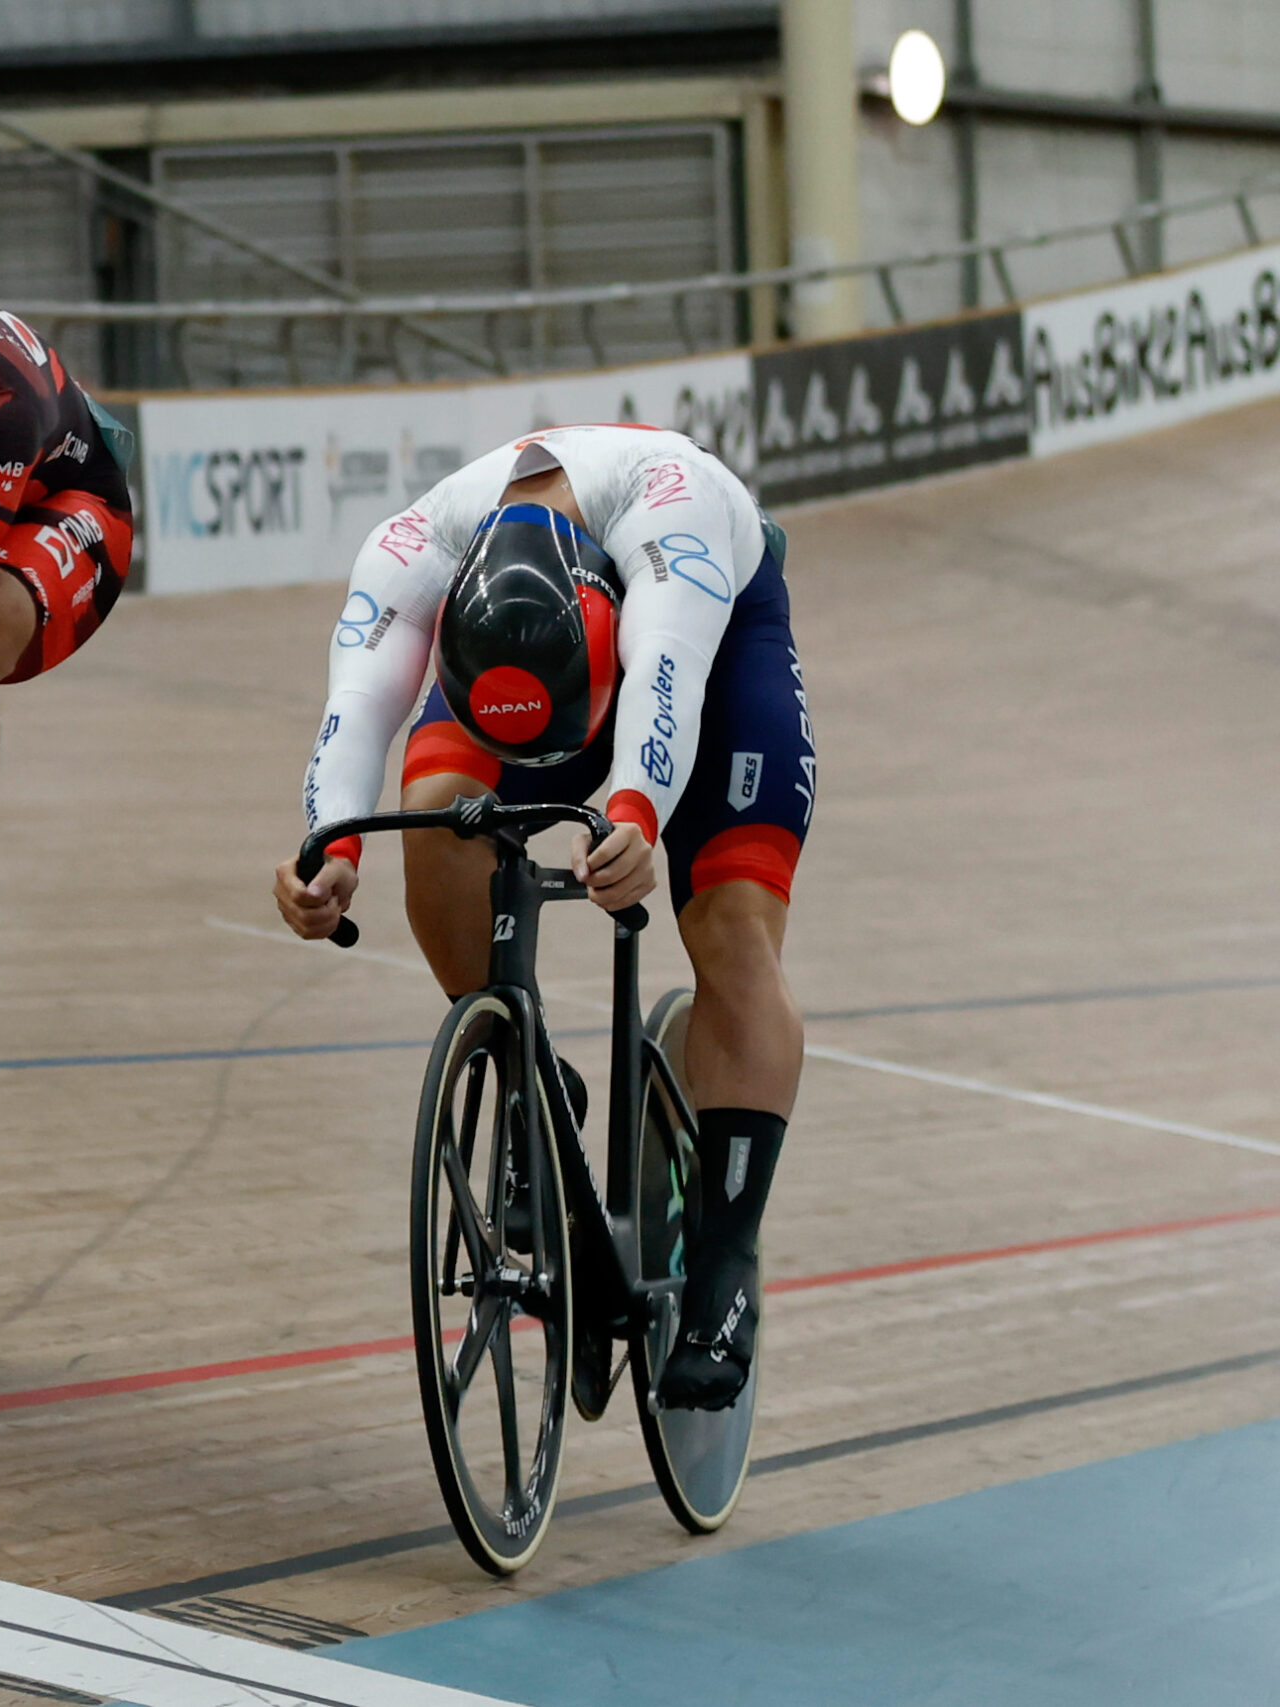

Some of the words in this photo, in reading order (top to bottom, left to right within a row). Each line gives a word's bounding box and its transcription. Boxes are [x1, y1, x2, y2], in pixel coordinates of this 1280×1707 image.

[59, 509, 104, 554] CIMB
[641, 540, 669, 583] KEIRIN
[364, 606, 398, 651] KEIRIN
[479, 700, 542, 714] JAPAN
[651, 654, 678, 740] Cyclers
